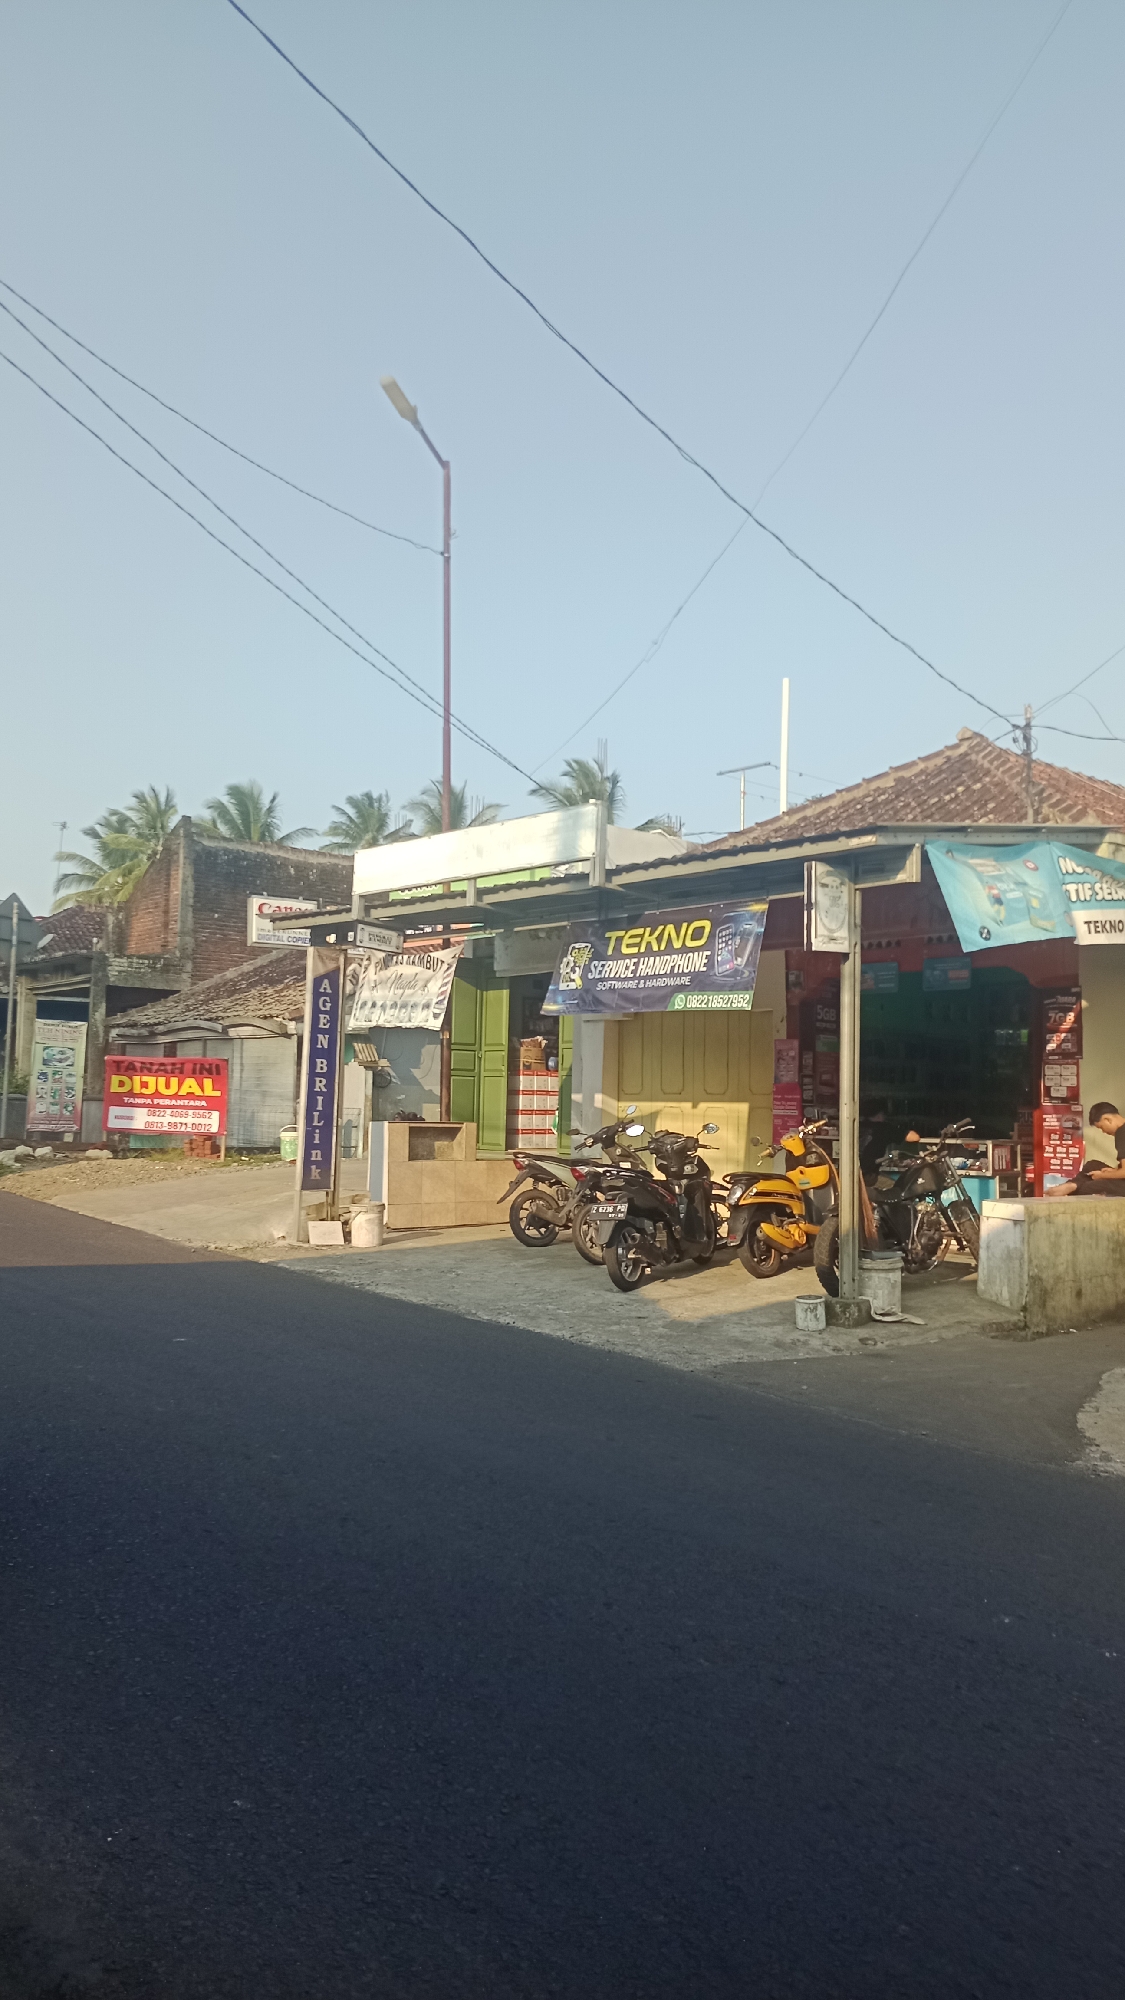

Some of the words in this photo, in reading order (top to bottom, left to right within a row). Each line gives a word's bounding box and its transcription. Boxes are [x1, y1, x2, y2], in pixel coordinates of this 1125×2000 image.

[1083, 919, 1125, 935] TEKNO
[287, 935, 310, 945] COPIE
[605, 920, 712, 955] TEKNO
[588, 958, 636, 979] SERVICE
[636, 951, 711, 976] HANDPHONE
[596, 980, 638, 991] SOFTWARE
[638, 981, 645, 989] &
[645, 976, 691, 988] HARDWARE
[686, 994, 750, 1008] 082218527952
[316, 978, 332, 1049] AGEN
[1048, 1011, 1075, 1024] 7GB
[113, 1060, 185, 1075] TANAH
[192, 1062, 221, 1076] INI
[110, 1074, 222, 1097] DIJUAL
[123, 1096, 153, 1105] TANPA
[153, 1098, 208, 1107] PERANTARA
